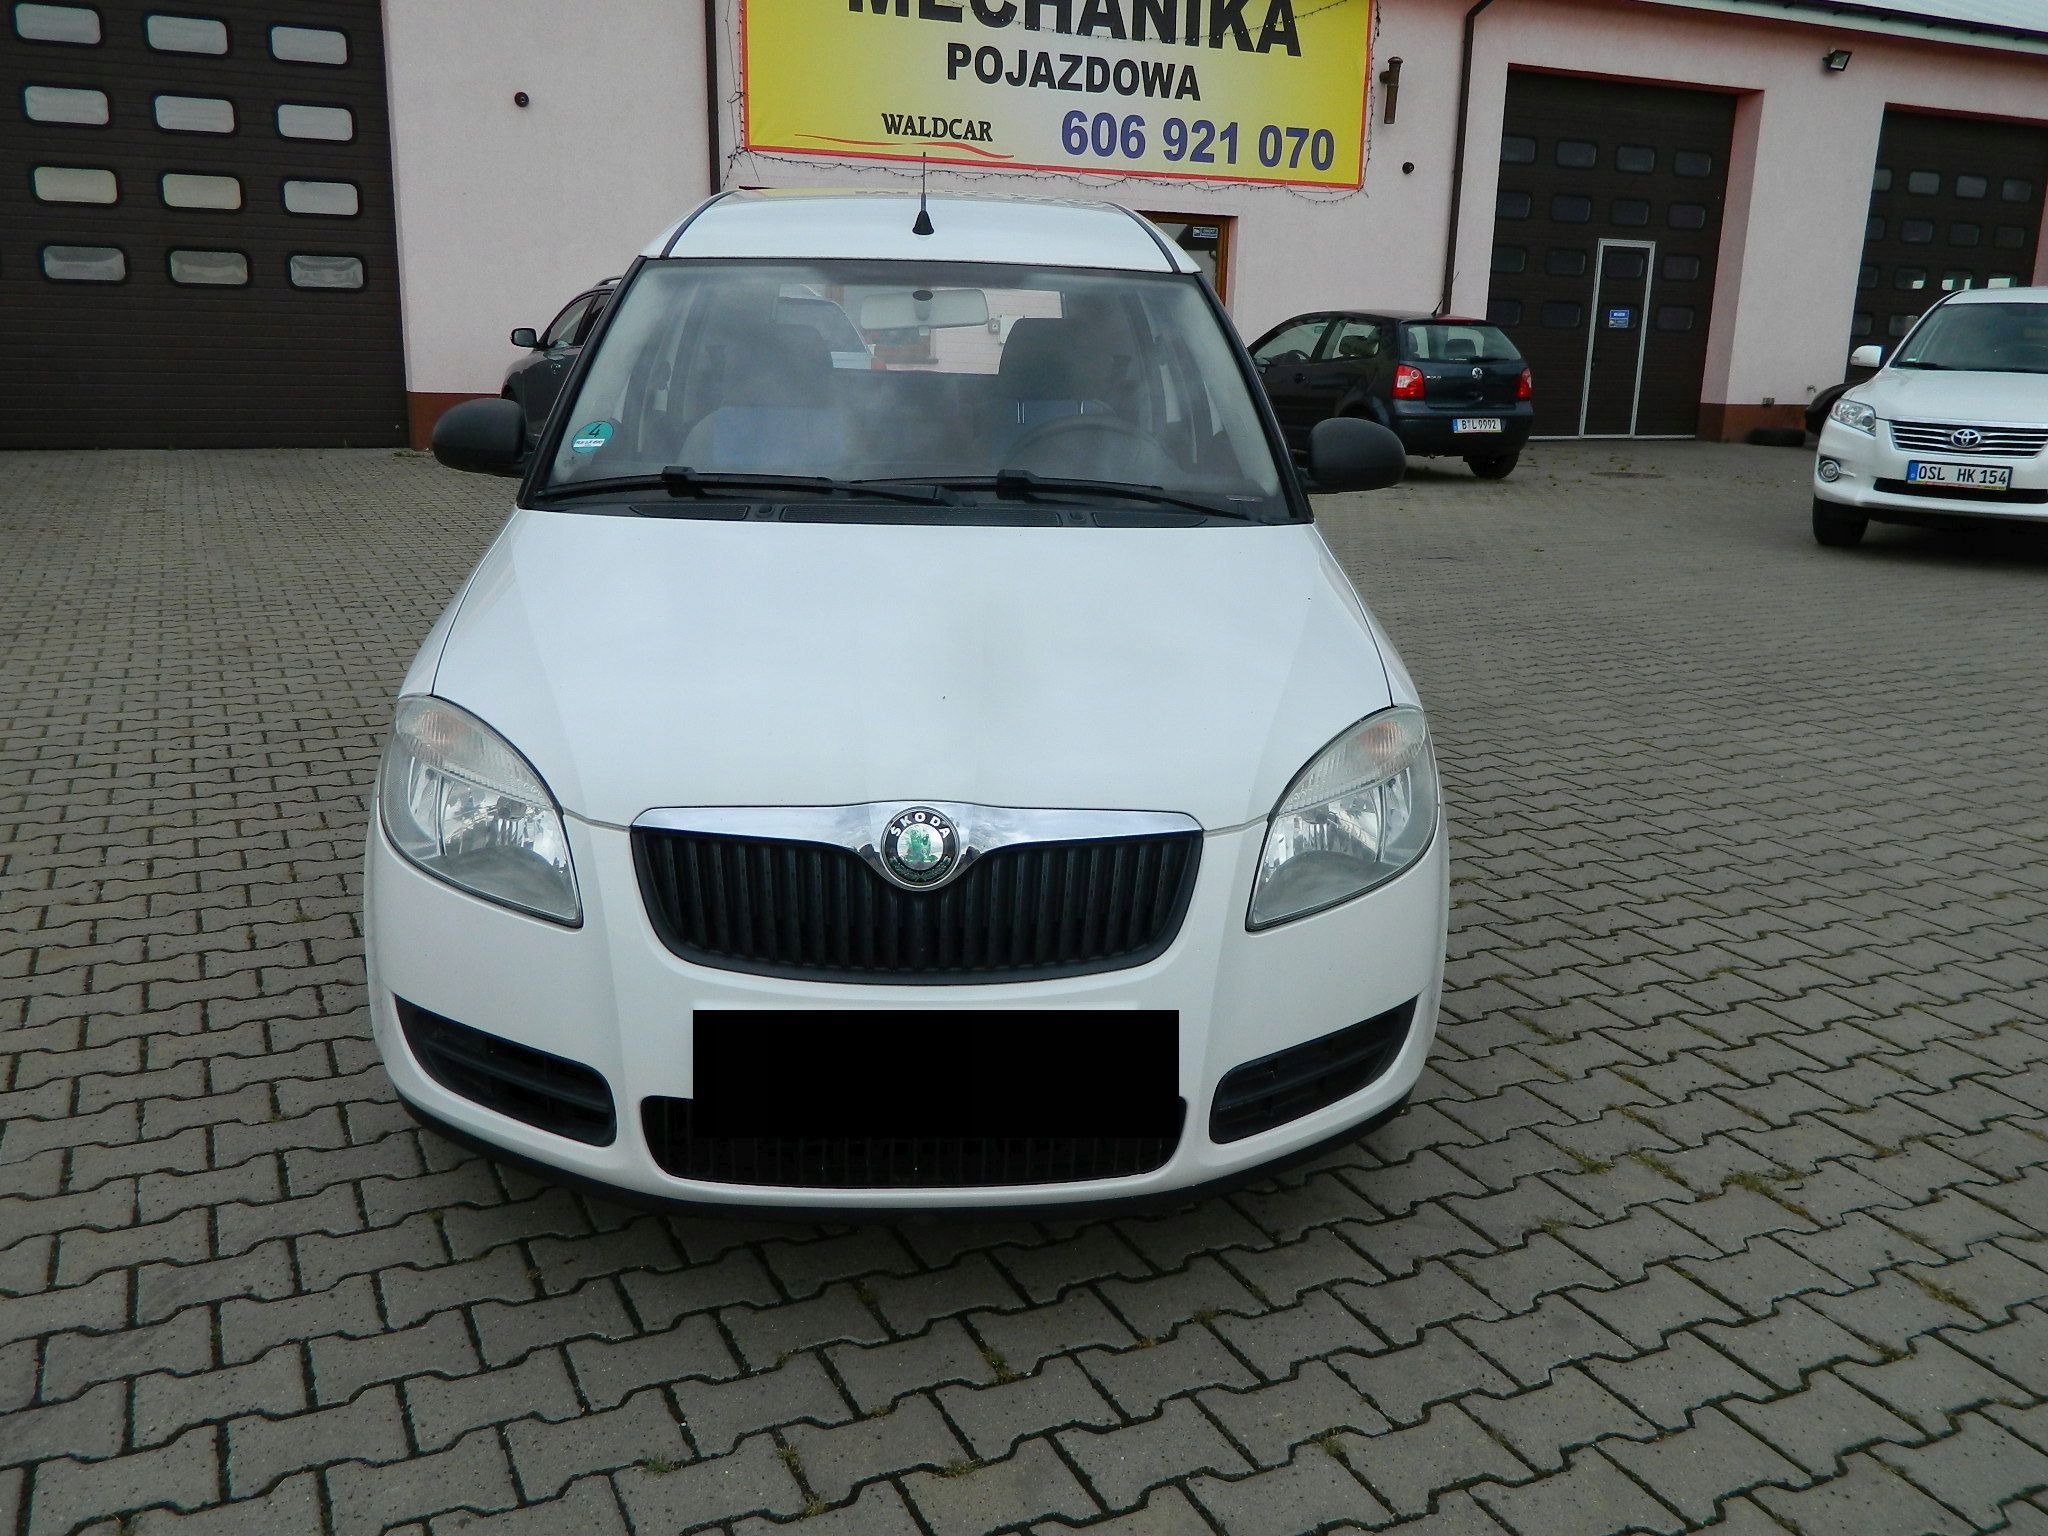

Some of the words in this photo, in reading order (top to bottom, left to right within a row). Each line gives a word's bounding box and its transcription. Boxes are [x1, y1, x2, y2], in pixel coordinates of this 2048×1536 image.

[947, 42, 1201, 101] POJAZDOWA
[881, 113, 993, 142] WALDCAR
[1061, 110, 1146, 159] 606
[1162, 117, 1239, 165] 921
[1258, 124, 1335, 171] 070
[588, 423, 602, 438] 4
[1918, 465, 1946, 481] OSL
[1956, 468, 1975, 483] HK
[1979, 469, 2007, 485] 154
